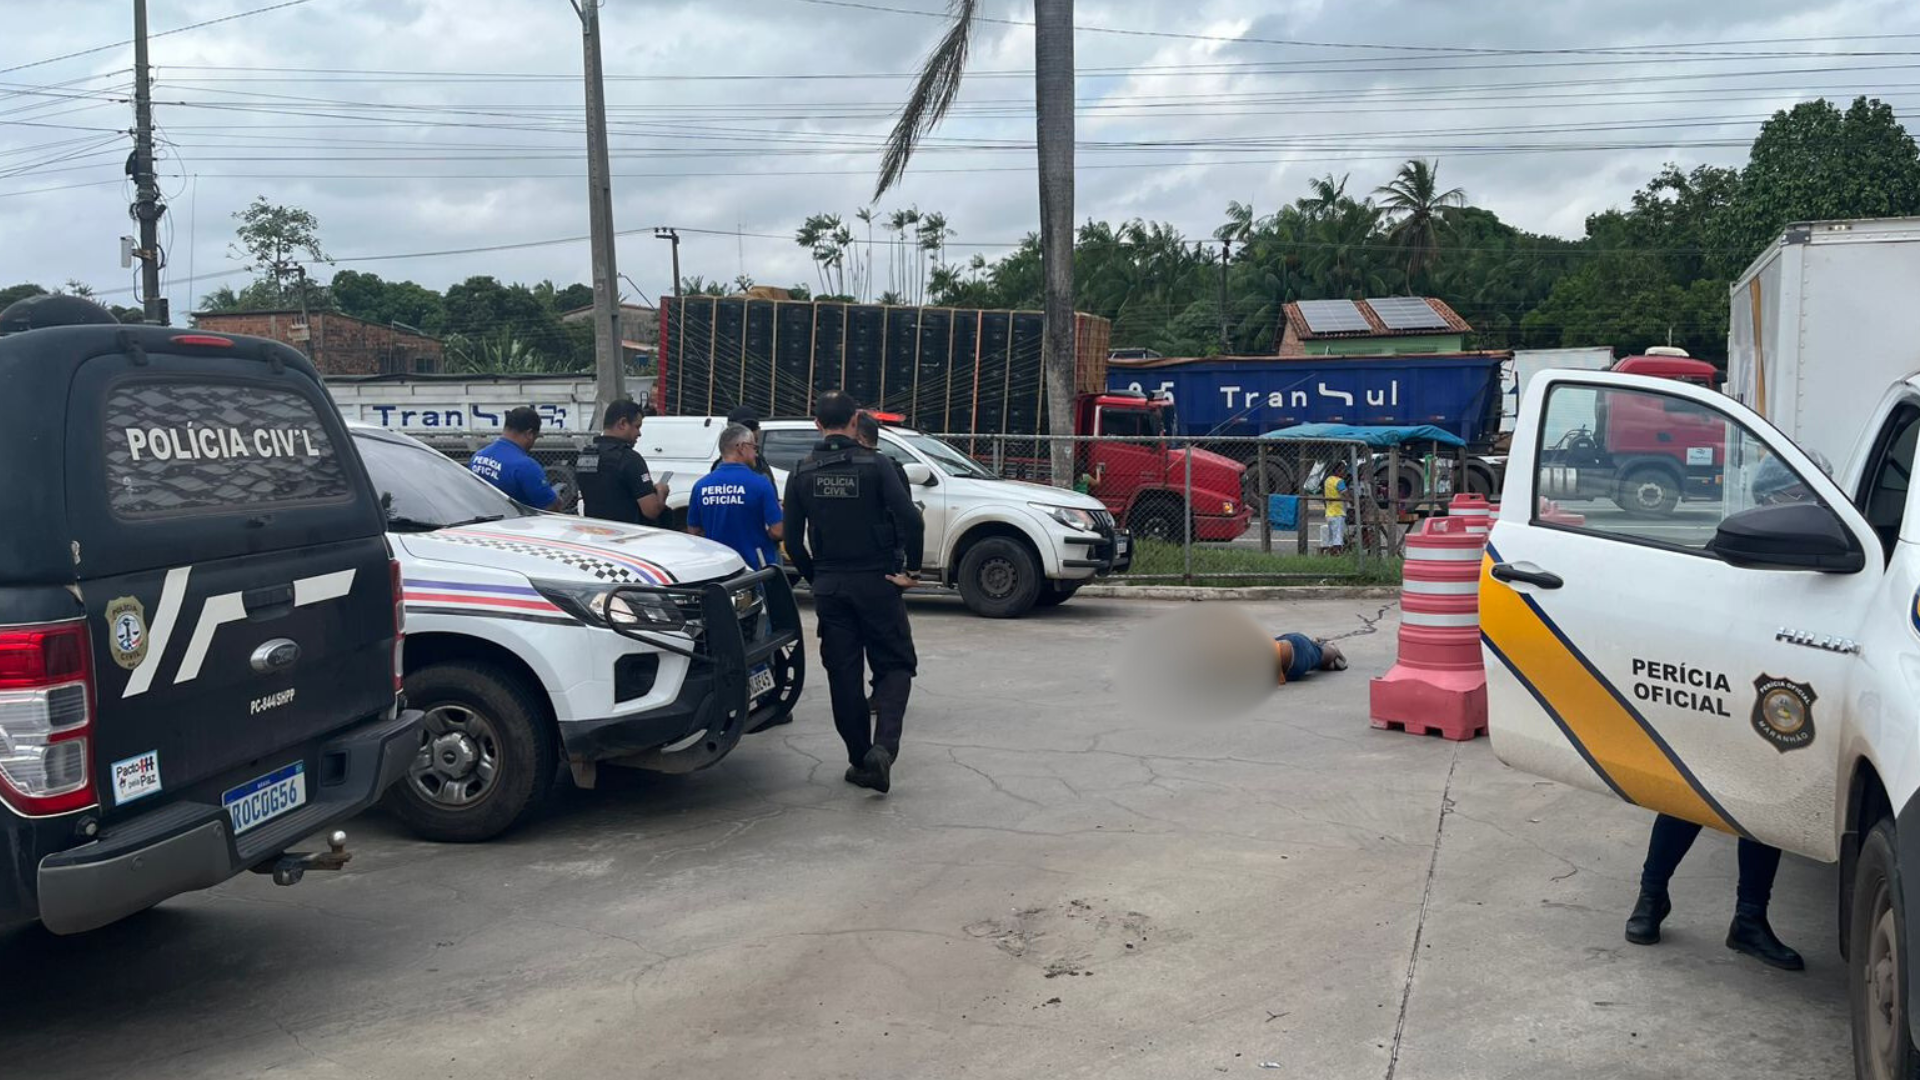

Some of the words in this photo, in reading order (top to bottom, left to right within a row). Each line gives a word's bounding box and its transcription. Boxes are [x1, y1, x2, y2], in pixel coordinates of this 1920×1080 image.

[125, 421, 250, 461] POLÍCIA
[701, 483, 746, 496] PERÍCIA
[816, 475, 856, 487] POLÍCIA
[702, 495, 745, 506] OFICIAL
[823, 487, 849, 496] CIVIL
[1774, 626, 1861, 656] HILUX
[1632, 658, 1732, 693] PERÍCIA
[1633, 682, 1732, 718] OFICIAL
[1759, 681, 1786, 694] PERÍCIA
[1786, 682, 1811, 706] OFICIAL
[1758, 720, 1808, 742] MARANHÃO
[116, 762, 140, 779] Pacto
[140, 773, 157, 787] Paz
